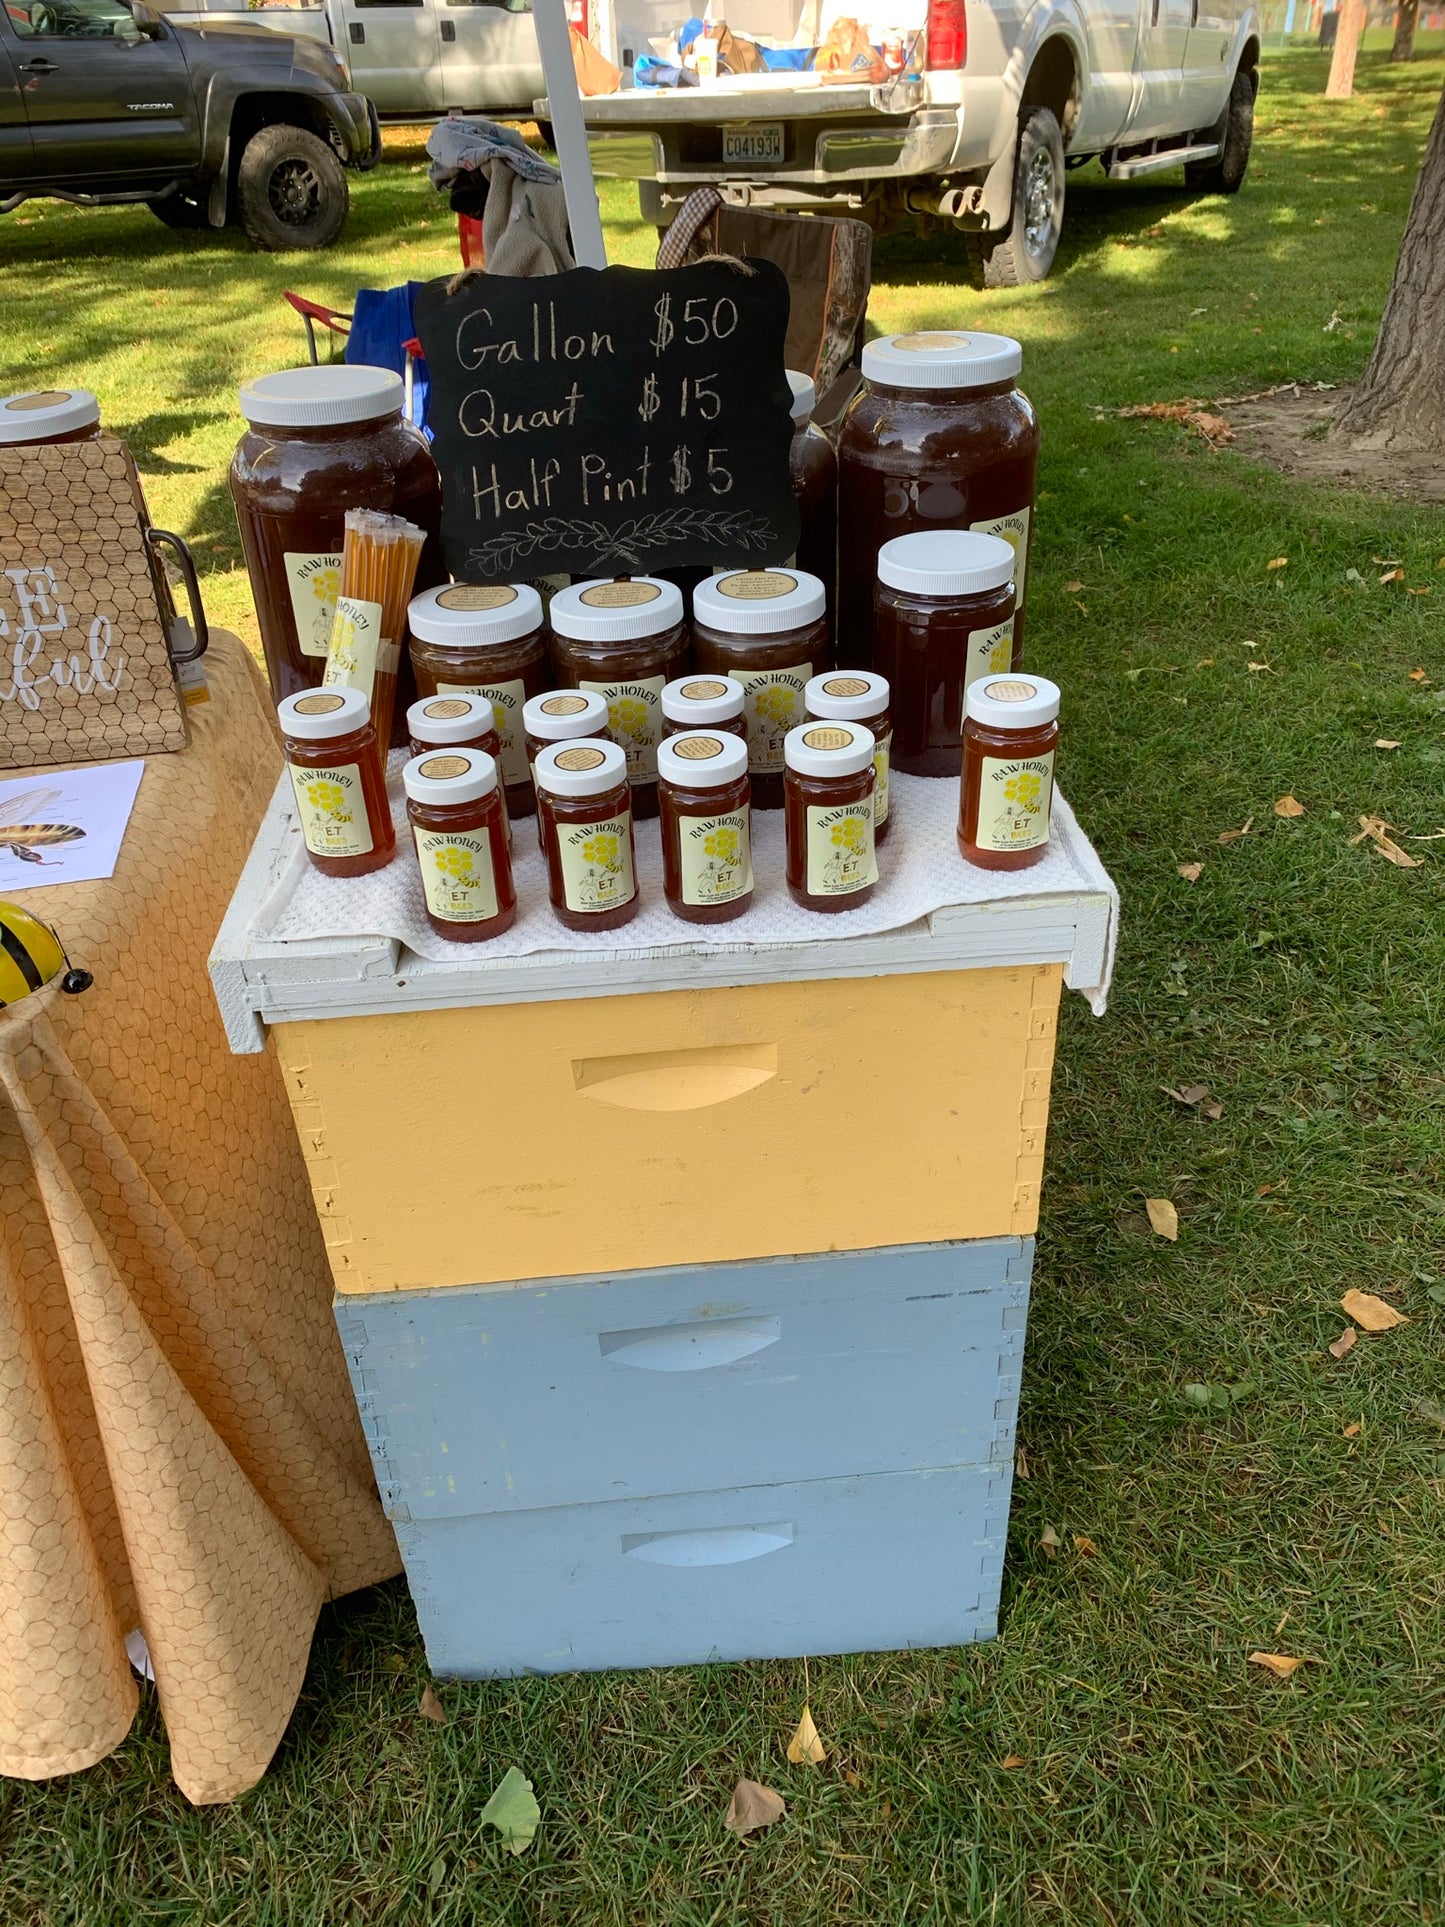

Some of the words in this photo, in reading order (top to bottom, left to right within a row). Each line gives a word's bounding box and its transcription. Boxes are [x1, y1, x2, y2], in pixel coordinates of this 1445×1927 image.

[126, 102, 175, 111] TACOMA
[456, 300, 615, 371] Gallon
[649, 292, 739, 358] $50
[457, 381, 585, 440] Quart
[471, 456, 562, 521] Half
[580, 445, 654, 506] Pint
[296, 556, 322, 580] RAW
[978, 627, 1003, 656] RAW
[769, 672, 806, 693] HONEY
[619, 685, 659, 706] HONEY
[295, 769, 316, 787] RAW
[316, 770, 354, 789] HONEY
[991, 763, 1021, 783] RAW
[1022, 760, 1051, 778] HONEY
[688, 819, 716, 840] RAW
[718, 815, 746, 832] HONEY
[815, 808, 845, 830] RAW
[846, 805, 872, 821] HONEY
[422, 835, 445, 852] RAW
[445, 834, 484, 854] HONEY
[567, 825, 595, 846] RAW
[595, 821, 626, 838] HONEY
